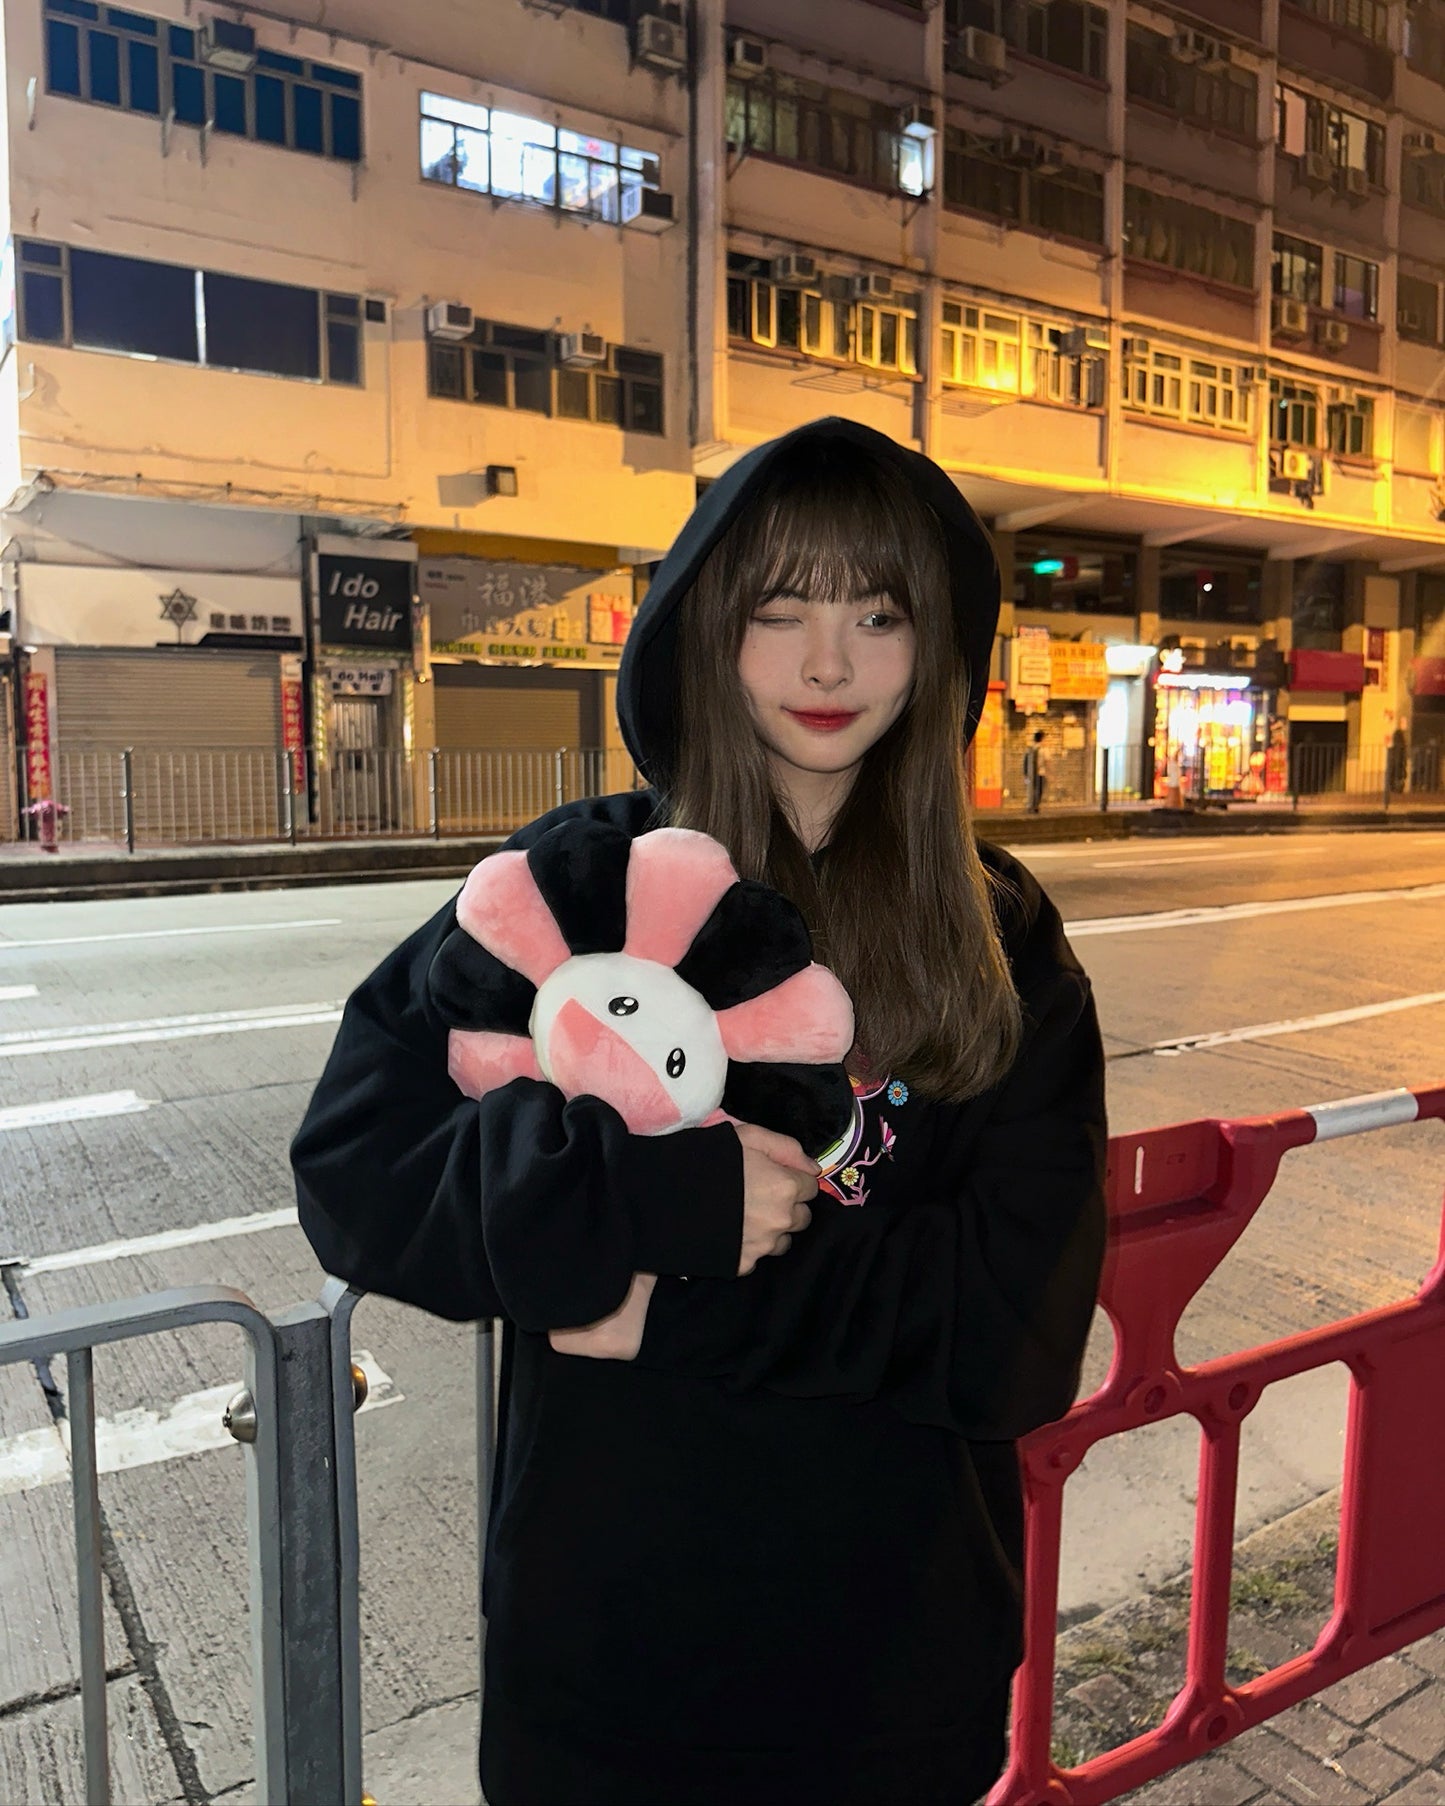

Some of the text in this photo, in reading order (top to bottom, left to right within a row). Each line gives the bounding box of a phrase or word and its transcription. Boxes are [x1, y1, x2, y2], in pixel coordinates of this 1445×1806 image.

[329, 570, 380, 599] I do
[343, 603, 403, 632] Hair
